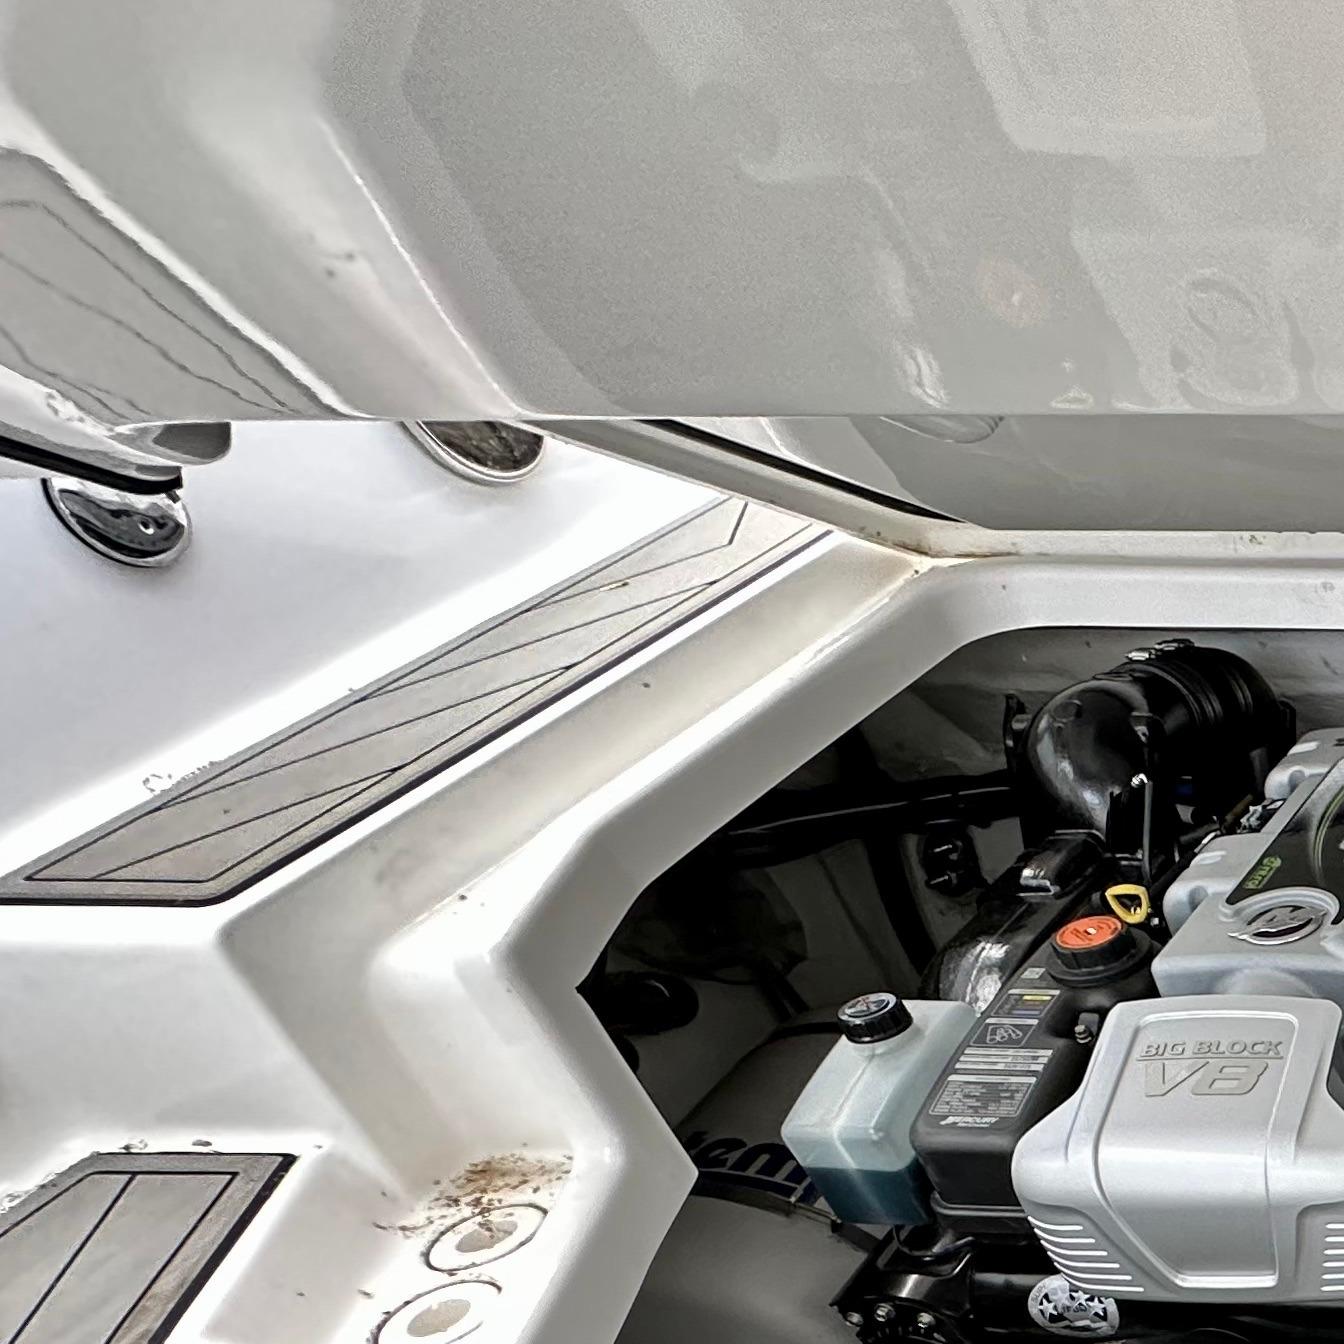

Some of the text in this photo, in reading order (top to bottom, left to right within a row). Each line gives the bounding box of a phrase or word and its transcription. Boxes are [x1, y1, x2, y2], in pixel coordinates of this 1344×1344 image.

[1139, 1040, 1284, 1057] BIG BLOCK
[1144, 1060, 1269, 1097] V8
